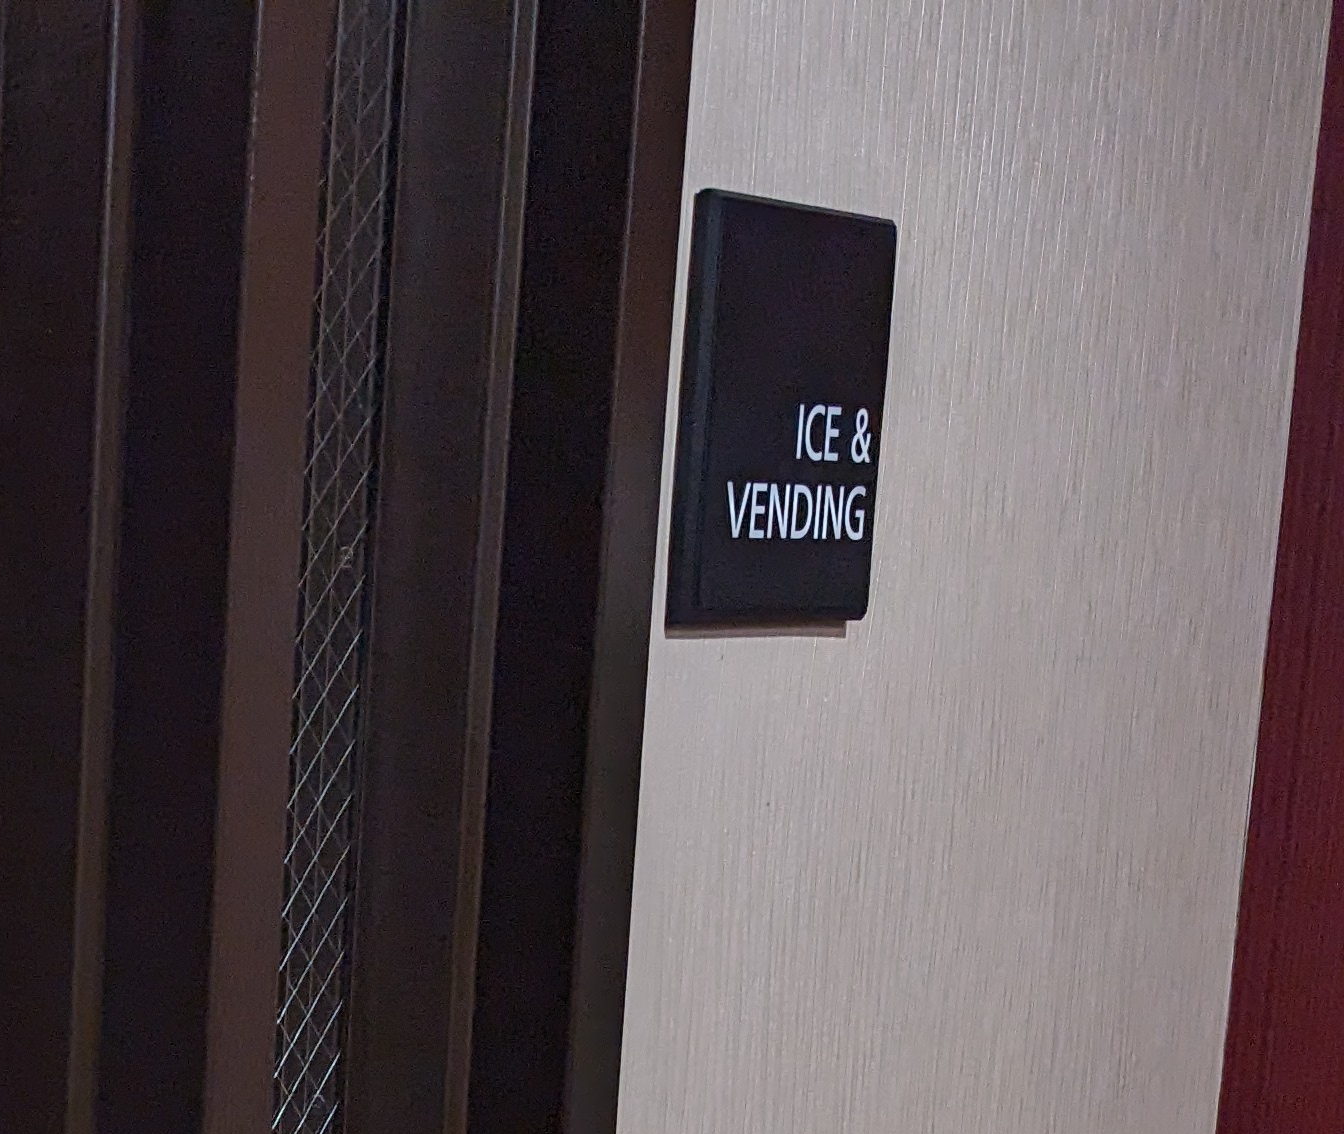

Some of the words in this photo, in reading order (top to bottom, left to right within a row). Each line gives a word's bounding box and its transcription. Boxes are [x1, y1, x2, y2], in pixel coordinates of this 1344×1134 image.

[795, 404, 842, 462] ICE
[850, 408, 871, 463] &
[727, 481, 866, 541] VENDING
